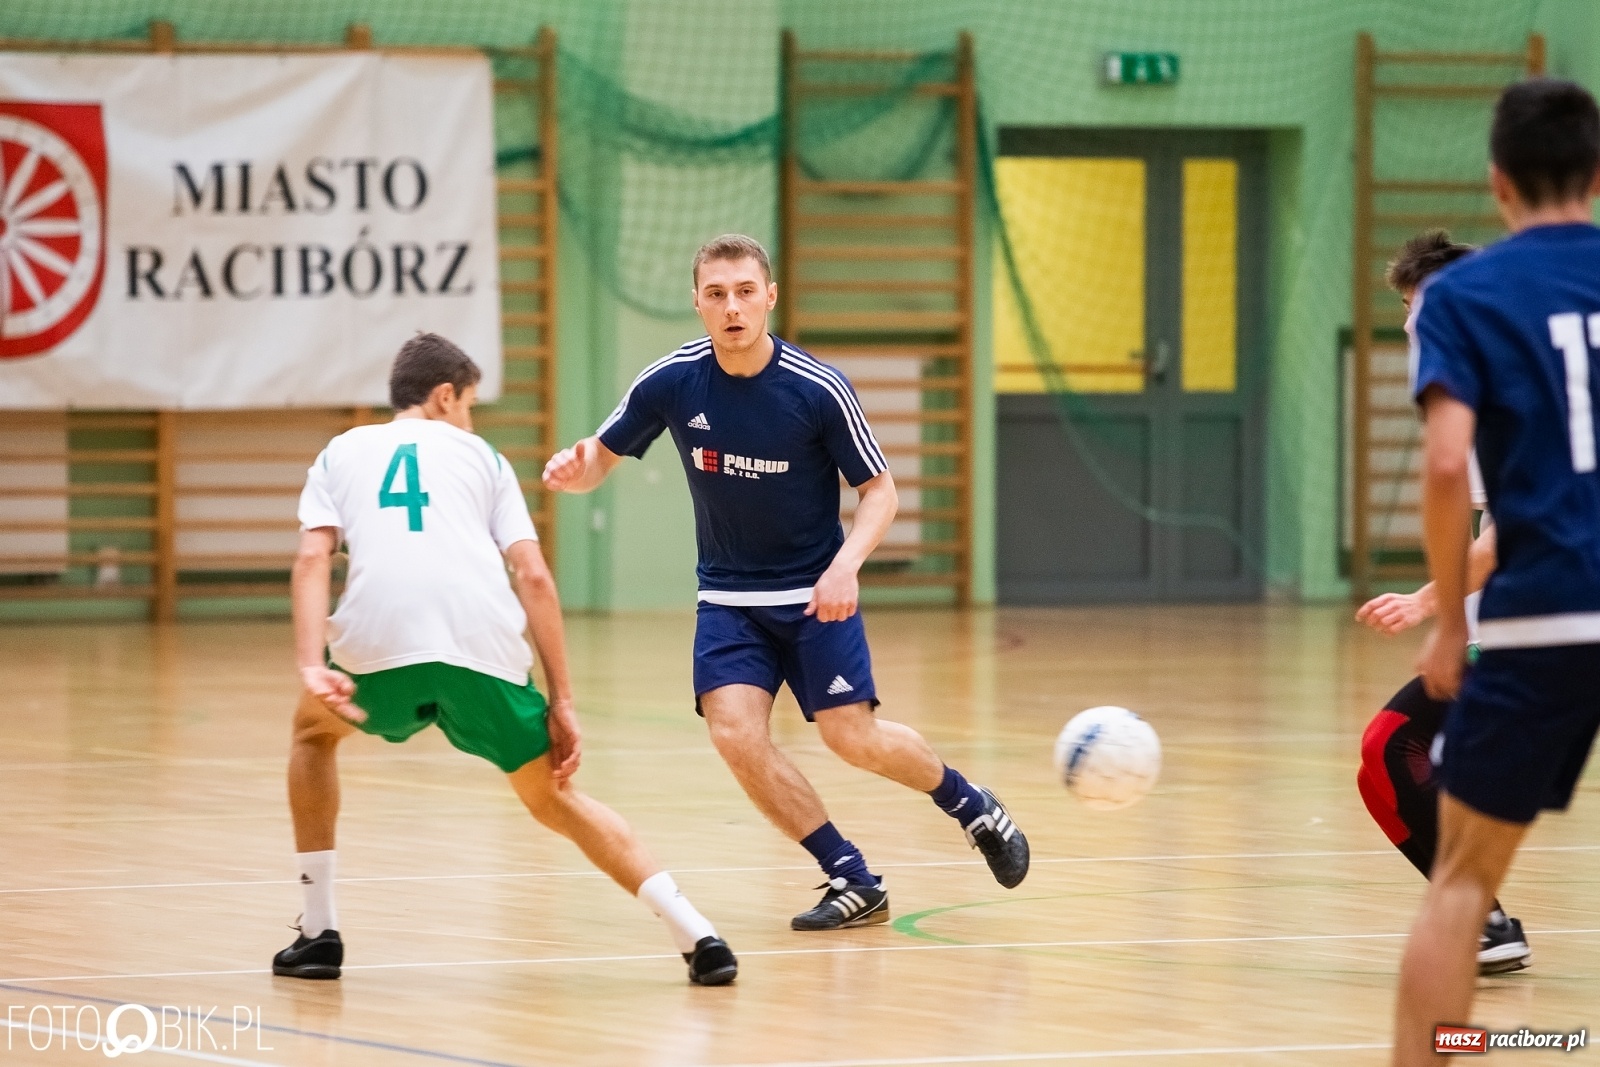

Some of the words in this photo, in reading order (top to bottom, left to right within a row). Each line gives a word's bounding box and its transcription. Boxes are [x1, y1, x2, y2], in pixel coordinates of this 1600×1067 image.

[171, 156, 429, 217] MIASTO
[124, 226, 476, 301] RACIBÓRZ
[687, 421, 711, 431] adidas
[723, 453, 789, 474] PALBUD
[723, 466, 737, 476] Sp.
[378, 443, 430, 532] 4
